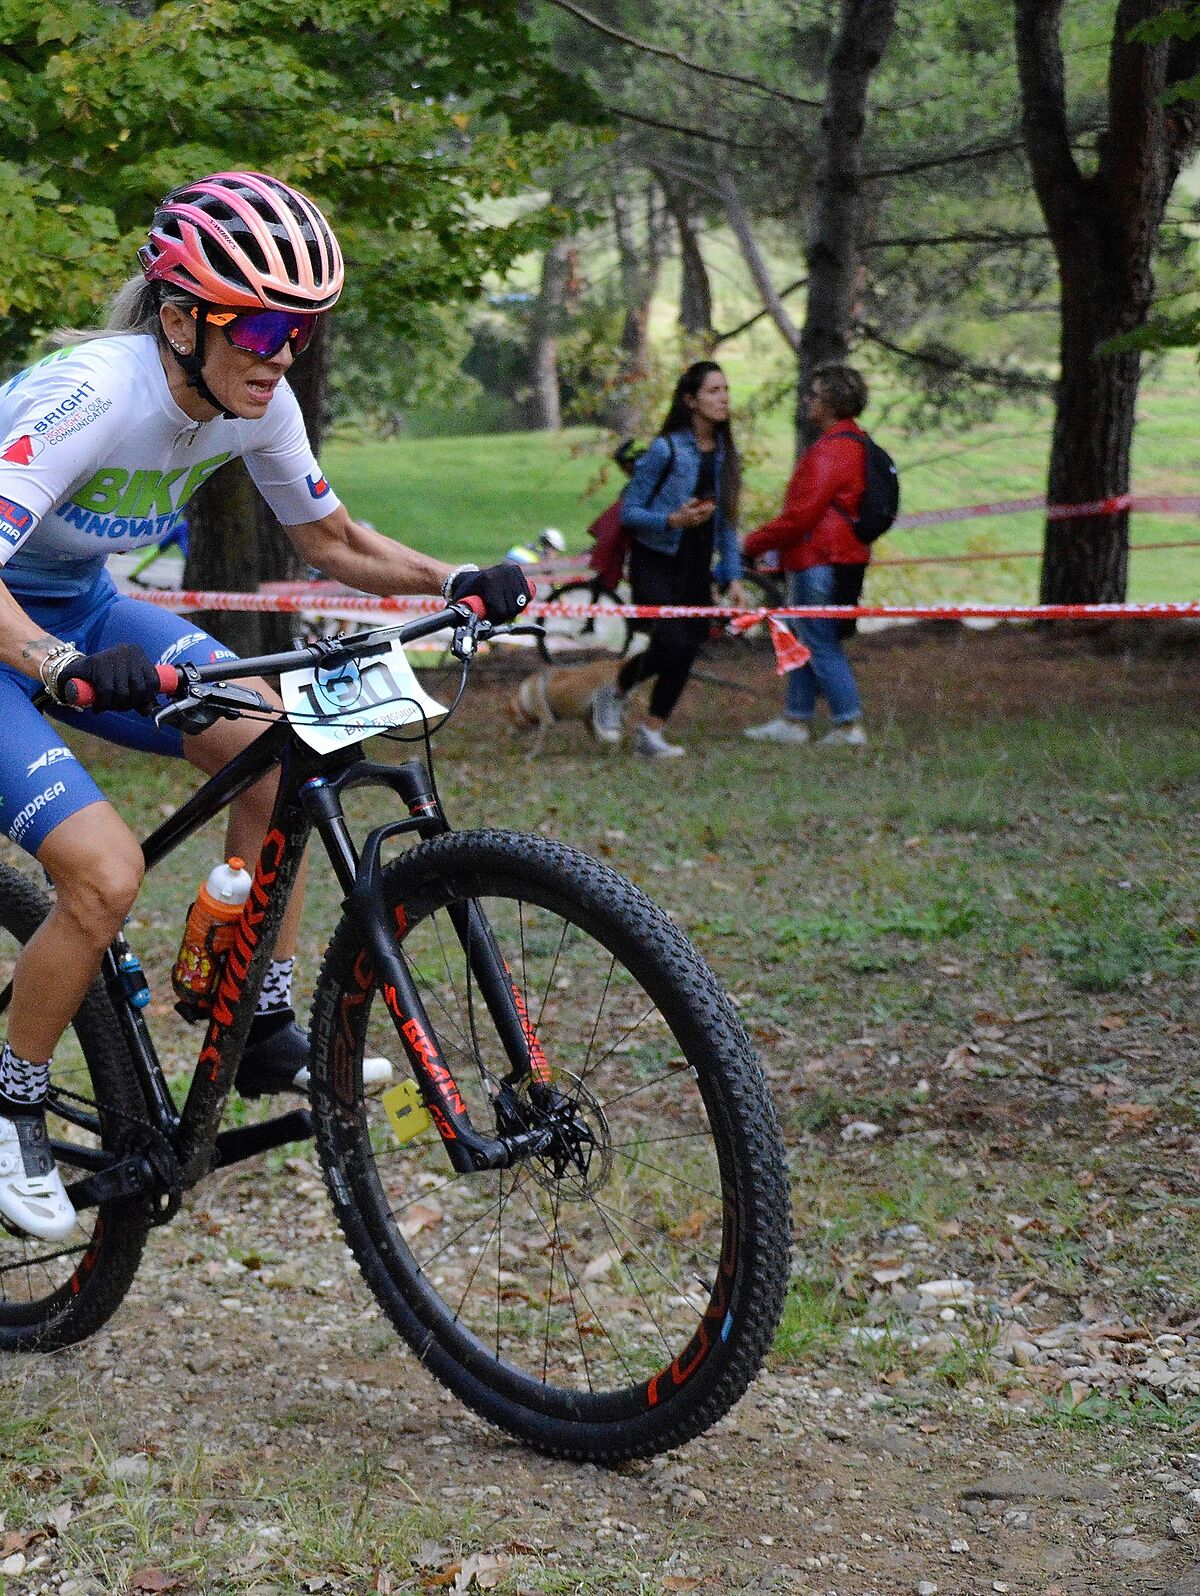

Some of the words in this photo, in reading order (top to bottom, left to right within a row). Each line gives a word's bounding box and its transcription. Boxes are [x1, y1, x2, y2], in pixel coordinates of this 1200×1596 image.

[34, 381, 96, 432] BRIGHT
[44, 413, 83, 441] HIGHLIGHT
[82, 397, 104, 415] YOUR
[49, 398, 113, 446] COMMUNICATION
[298, 661, 403, 726] 130
[401, 1018, 468, 1115] BRAIN
